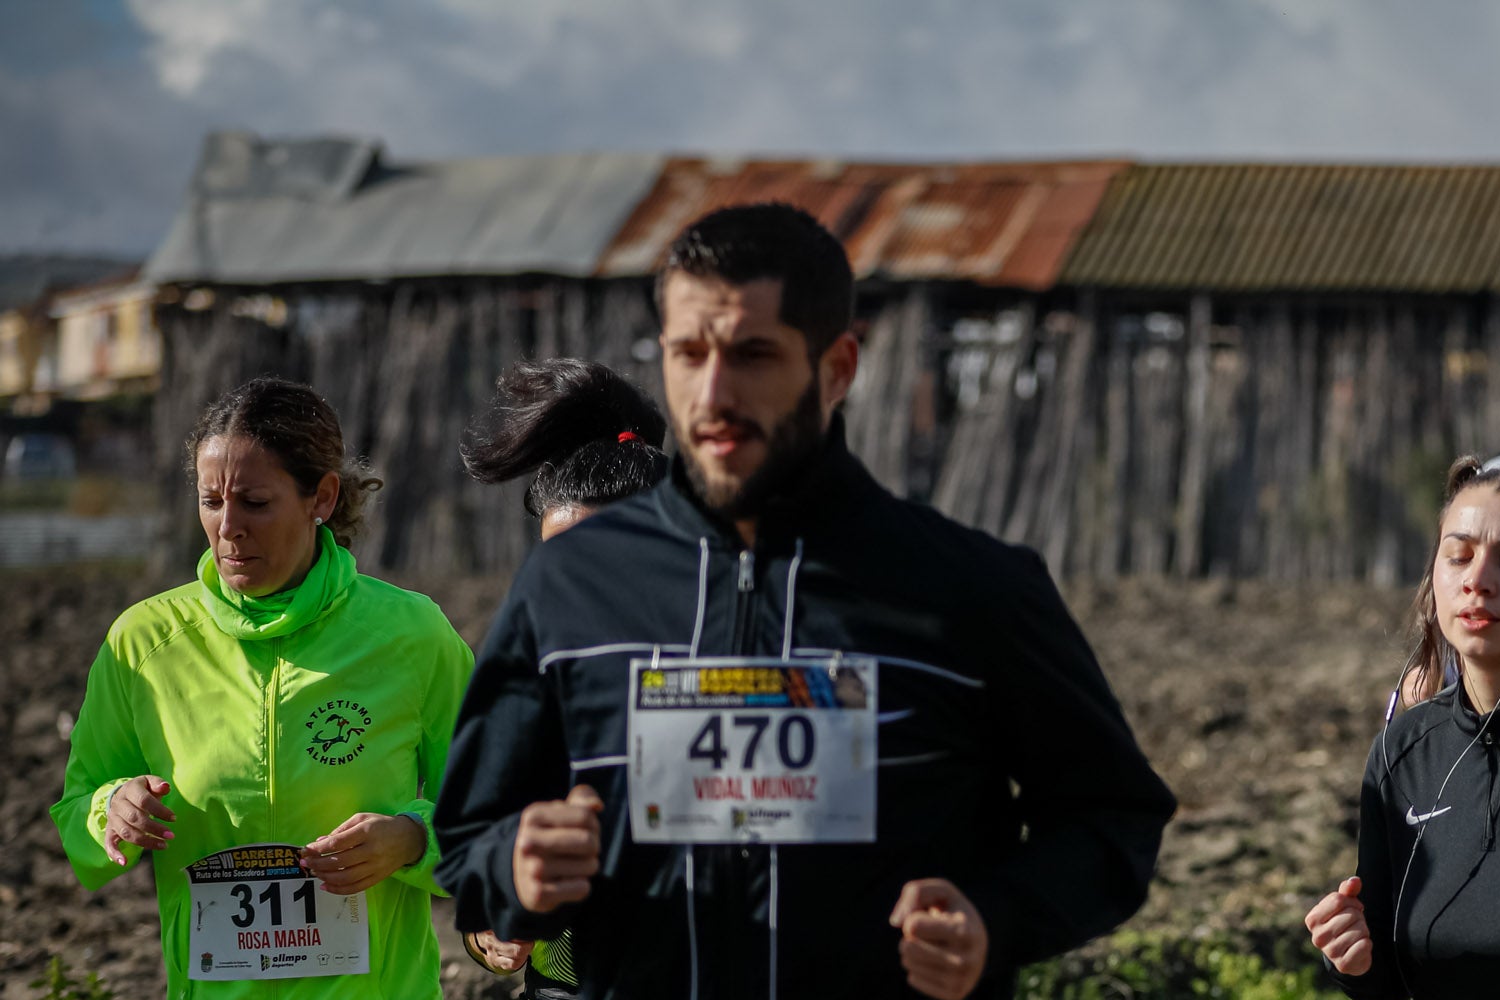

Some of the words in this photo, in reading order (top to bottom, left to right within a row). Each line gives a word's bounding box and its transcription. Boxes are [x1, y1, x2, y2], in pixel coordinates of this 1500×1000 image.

[306, 700, 371, 729] ATLETISMO
[689, 715, 816, 769] 470
[693, 777, 745, 800] VIDAL
[751, 773, 817, 800] MUÑOZ
[219, 852, 235, 869] VII
[233, 849, 294, 860] CARRERA
[235, 858, 295, 869] POPULAR
[196, 871, 212, 879] Ruta
[212, 870, 221, 878] de
[222, 869, 232, 878] los
[233, 868, 265, 878] Secaderos
[230, 880, 317, 928] 311
[237, 931, 271, 950] ROSA
[274, 925, 321, 948] MARÍA
[273, 953, 307, 963] olimpo
